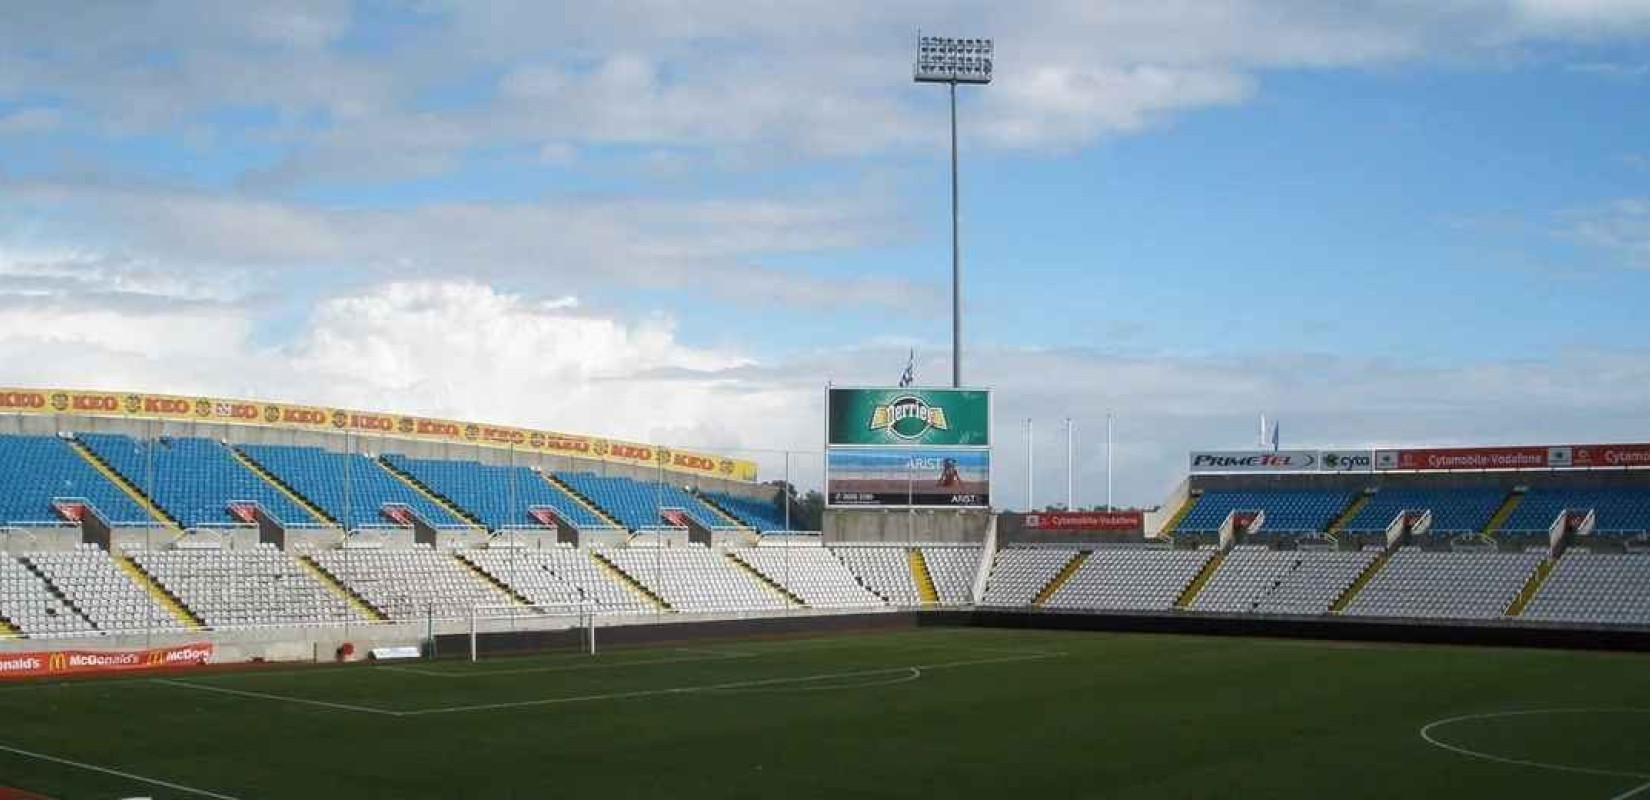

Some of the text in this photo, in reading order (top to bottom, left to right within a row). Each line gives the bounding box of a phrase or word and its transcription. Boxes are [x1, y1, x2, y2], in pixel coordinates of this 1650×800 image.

[72, 395, 119, 411] KEO
[145, 396, 189, 413] KEO
[282, 408, 326, 424] KEO
[350, 414, 393, 431] KEO
[416, 420, 460, 436] KEO
[611, 443, 652, 460] KEO
[673, 453, 715, 471] KEO
[1340, 456, 1370, 471] cyta
[0, 656, 41, 672] nald's
[70, 653, 139, 666] McDonald's
